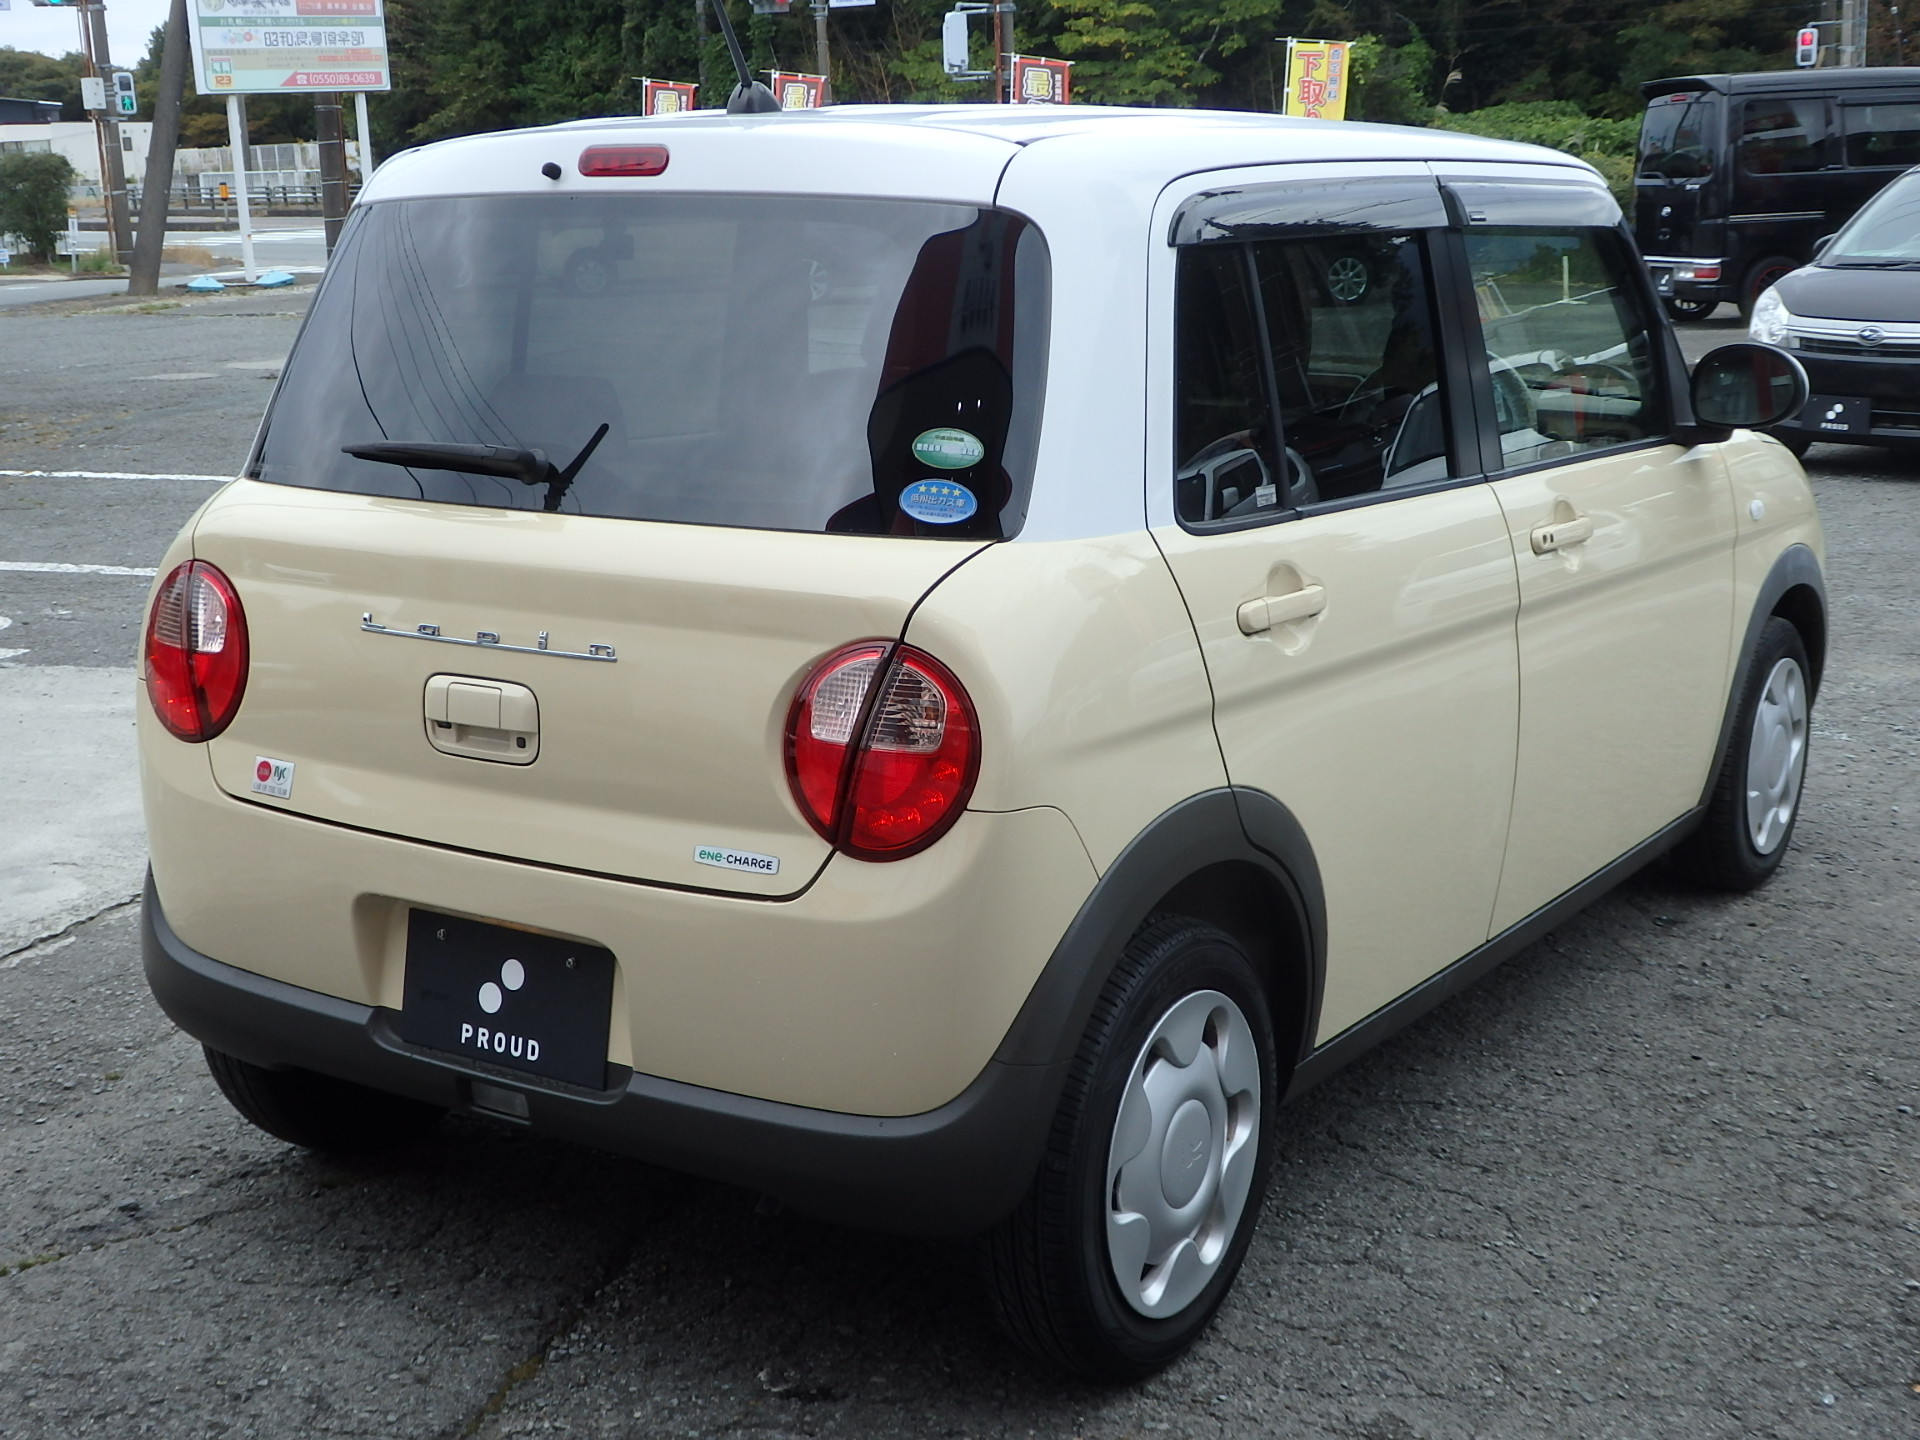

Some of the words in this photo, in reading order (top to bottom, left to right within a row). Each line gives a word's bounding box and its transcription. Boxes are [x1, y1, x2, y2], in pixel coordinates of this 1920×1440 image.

[309, 73, 375, 85] (0550)89-0639
[1023, 67, 1052, 104] 最
[461, 1023, 539, 1061] PROUD
